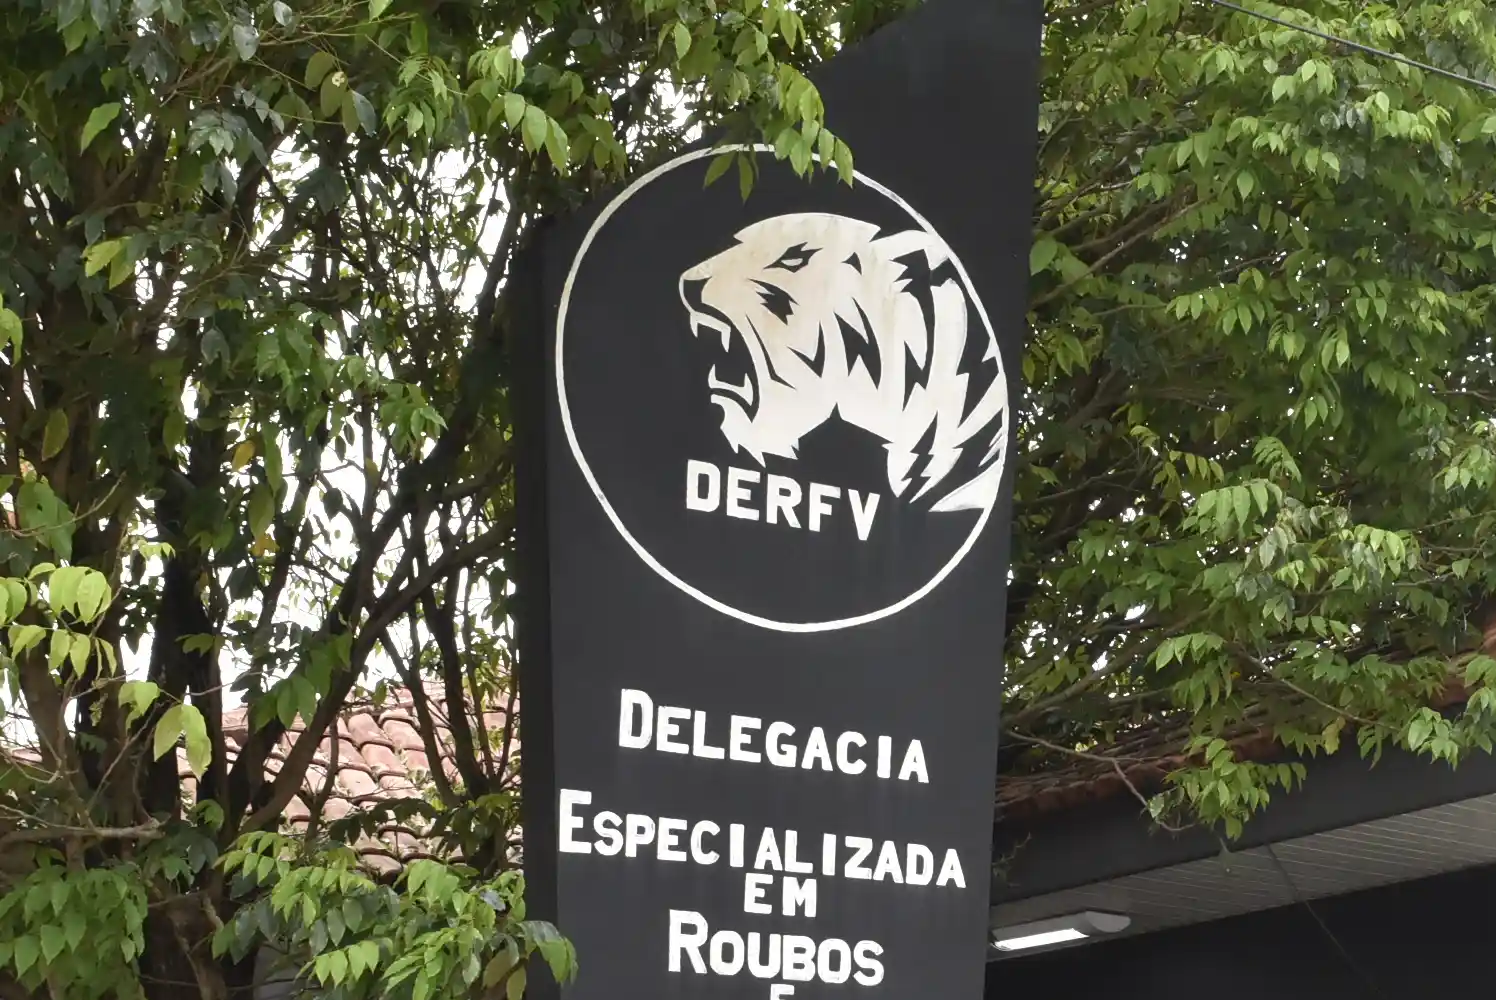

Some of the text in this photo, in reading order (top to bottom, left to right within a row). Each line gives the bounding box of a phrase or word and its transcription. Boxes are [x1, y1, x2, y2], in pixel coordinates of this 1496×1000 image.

[685, 459, 881, 541] DERFV
[618, 688, 930, 784] DELEGACIA
[558, 788, 967, 889] ESPECIALIZADA
[743, 872, 818, 918] EM
[668, 908, 885, 987] ROUBOS
